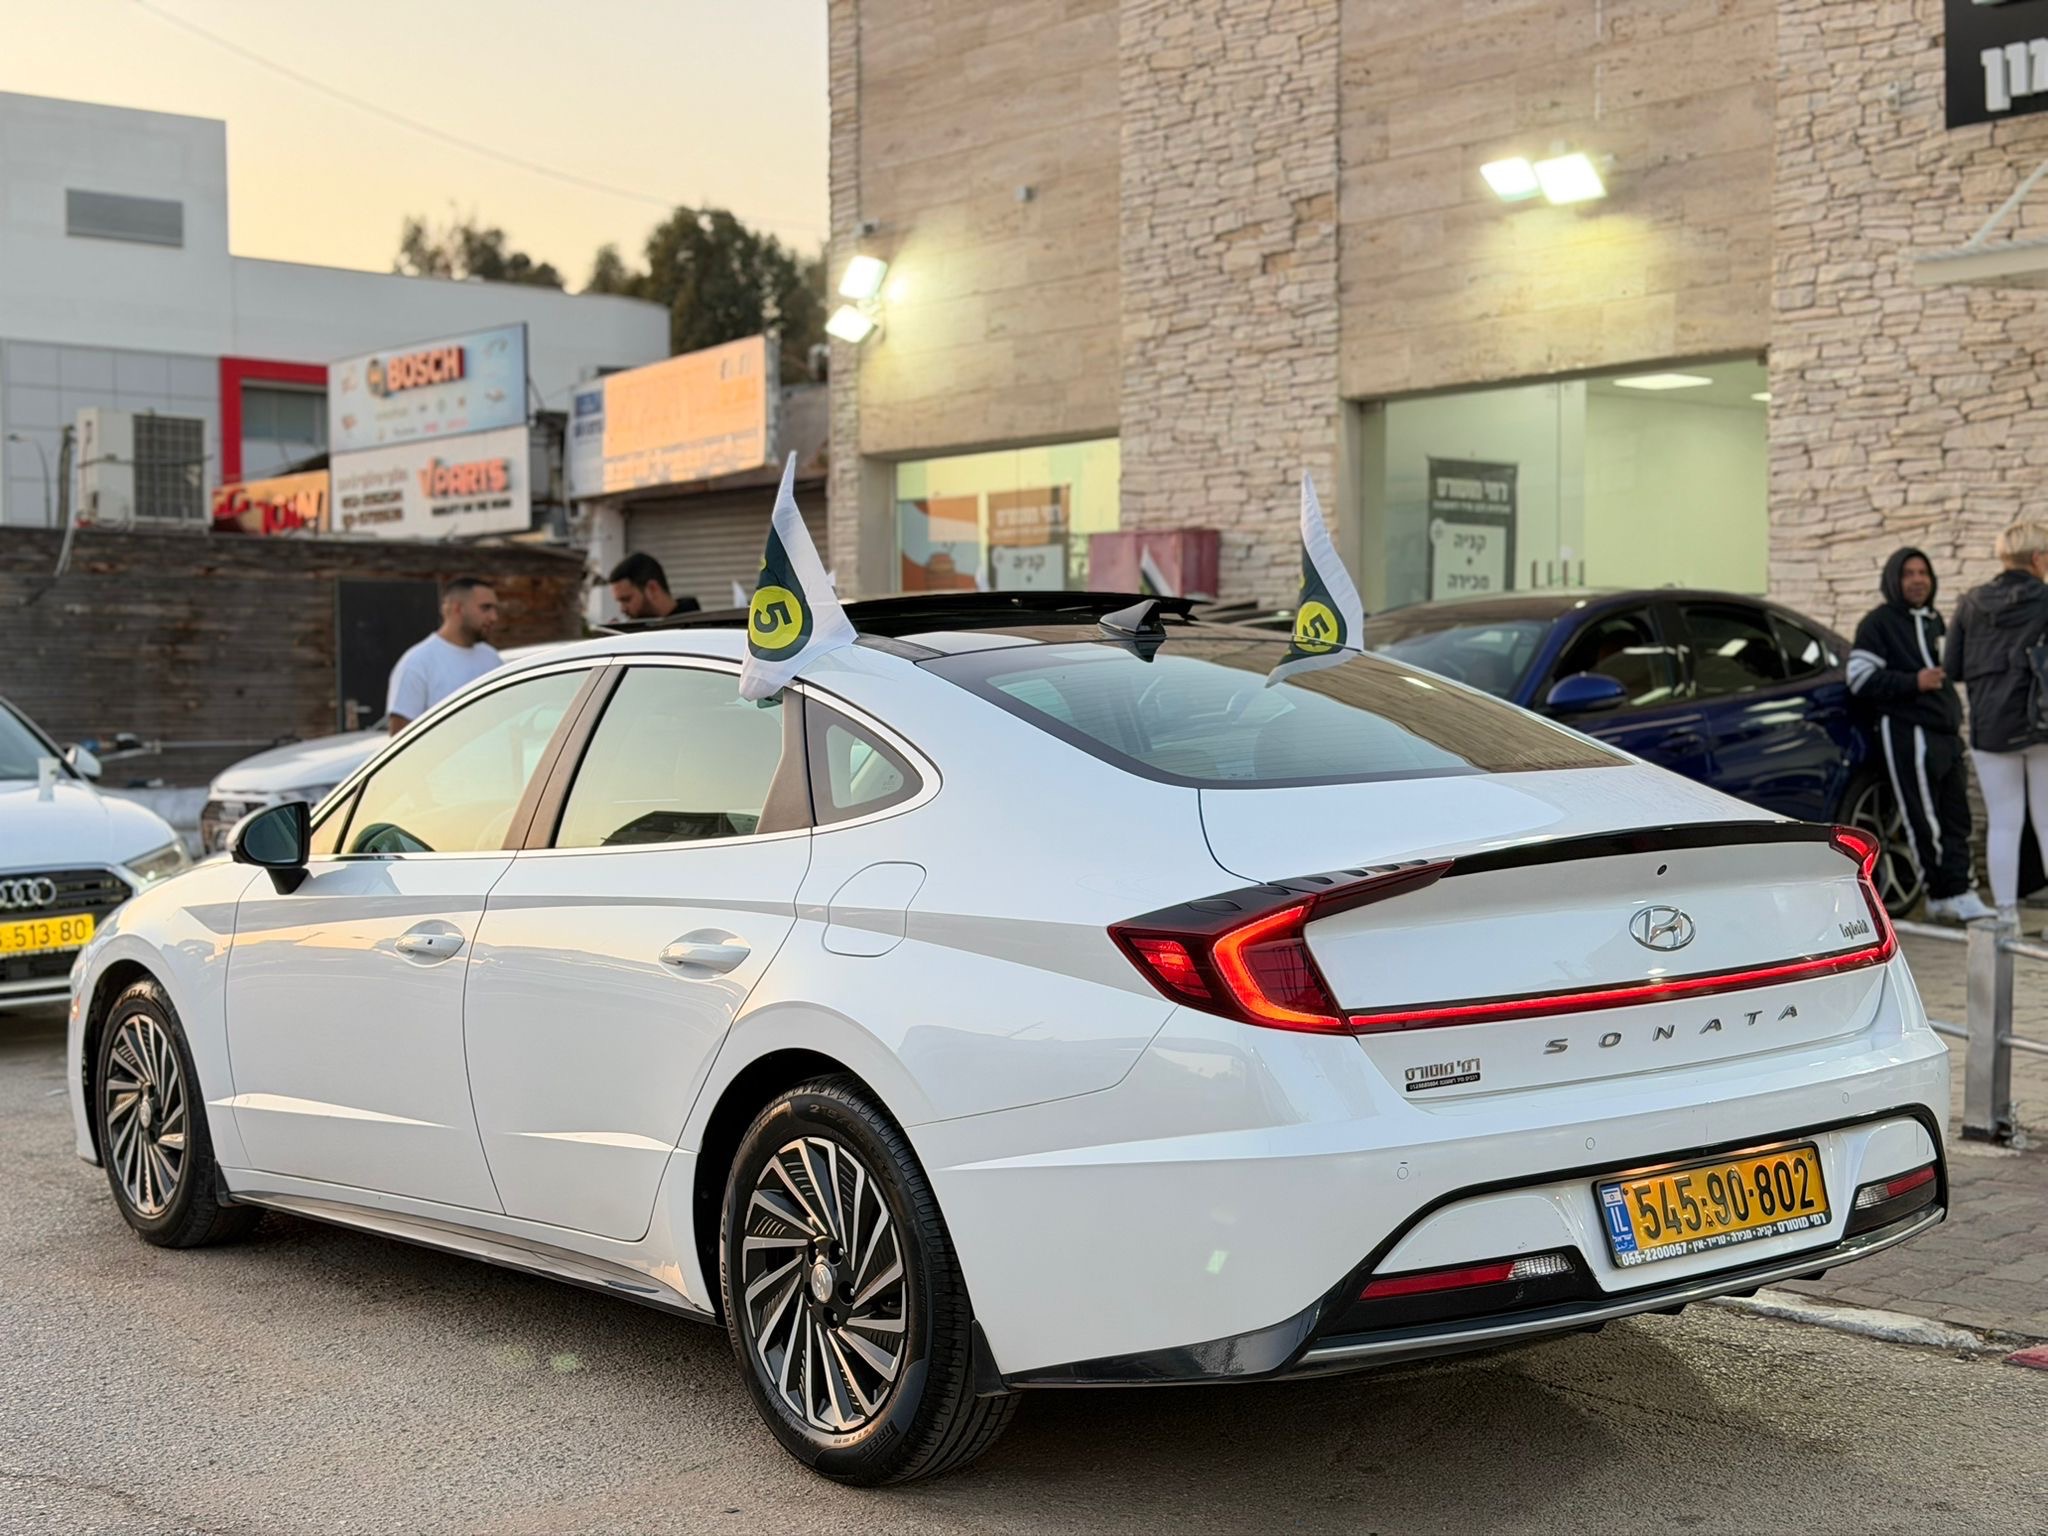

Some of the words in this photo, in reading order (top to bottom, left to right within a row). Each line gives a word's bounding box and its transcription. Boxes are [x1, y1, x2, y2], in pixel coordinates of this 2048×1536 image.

[387, 346, 465, 392] BOSCH
[753, 600, 793, 634] 5
[1543, 1004, 1799, 1055] SONATA
[1405, 1062, 1455, 1081] מוטורס
[1456, 1058, 1480, 1074] רמי
[1610, 1207, 1629, 1233] IL
[1776, 1216, 1810, 1234] מוטורס
[1809, 1213, 1828, 1226] רמי
[1731, 1229, 1753, 1243] מכירה
[1756, 1224, 1774, 1238] קניה
[1621, 1241, 1688, 1266] 055-2200057
